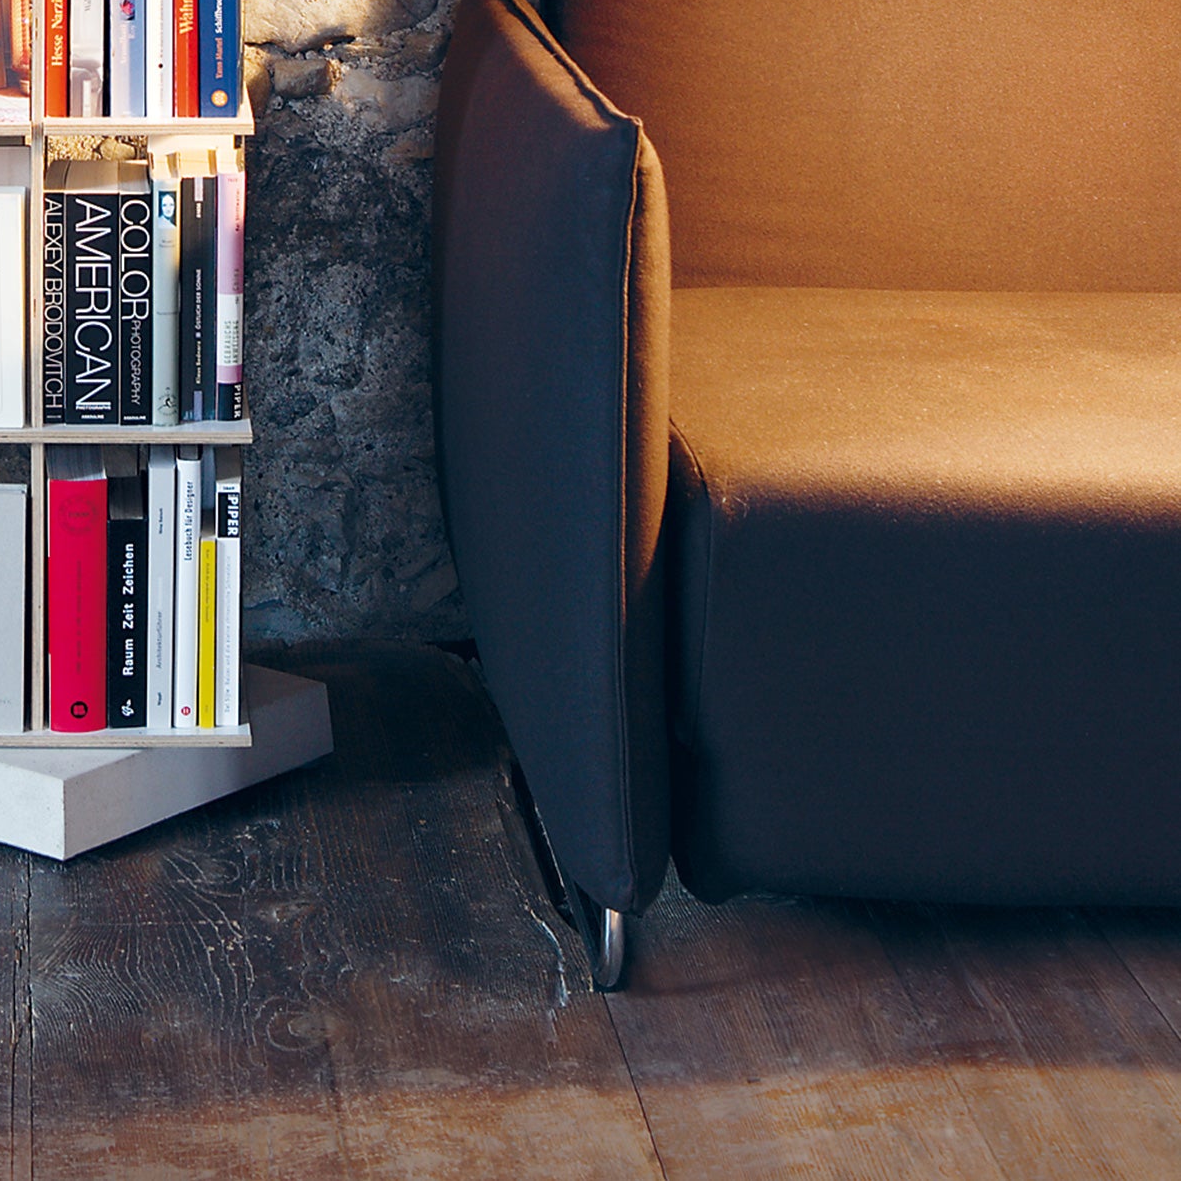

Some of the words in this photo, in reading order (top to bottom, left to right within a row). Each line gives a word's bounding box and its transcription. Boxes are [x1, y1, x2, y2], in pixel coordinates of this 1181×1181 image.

[51, 34, 63, 66] Hesse
[215, 61, 223, 79] Yann
[44, 197, 63, 273] ALEXEY
[120, 199, 151, 321] COLOR
[74, 198, 113, 406] AMERICAN
[44, 277, 64, 408] BRODOVITCH
[223, 320, 231, 364] GEBRAUCHS
[130, 320, 142, 406] PHOTOGRAPHY
[234, 384, 242, 419] PIPER
[183, 481, 195, 513] Designer
[227, 496, 239, 536] PIPER
[183, 515, 192, 526] für
[183, 528, 192, 561] Lesebuch
[122, 543, 134, 595] Zeichen
[122, 602, 134, 630] Zeit
[122, 638, 134, 676] Raum
